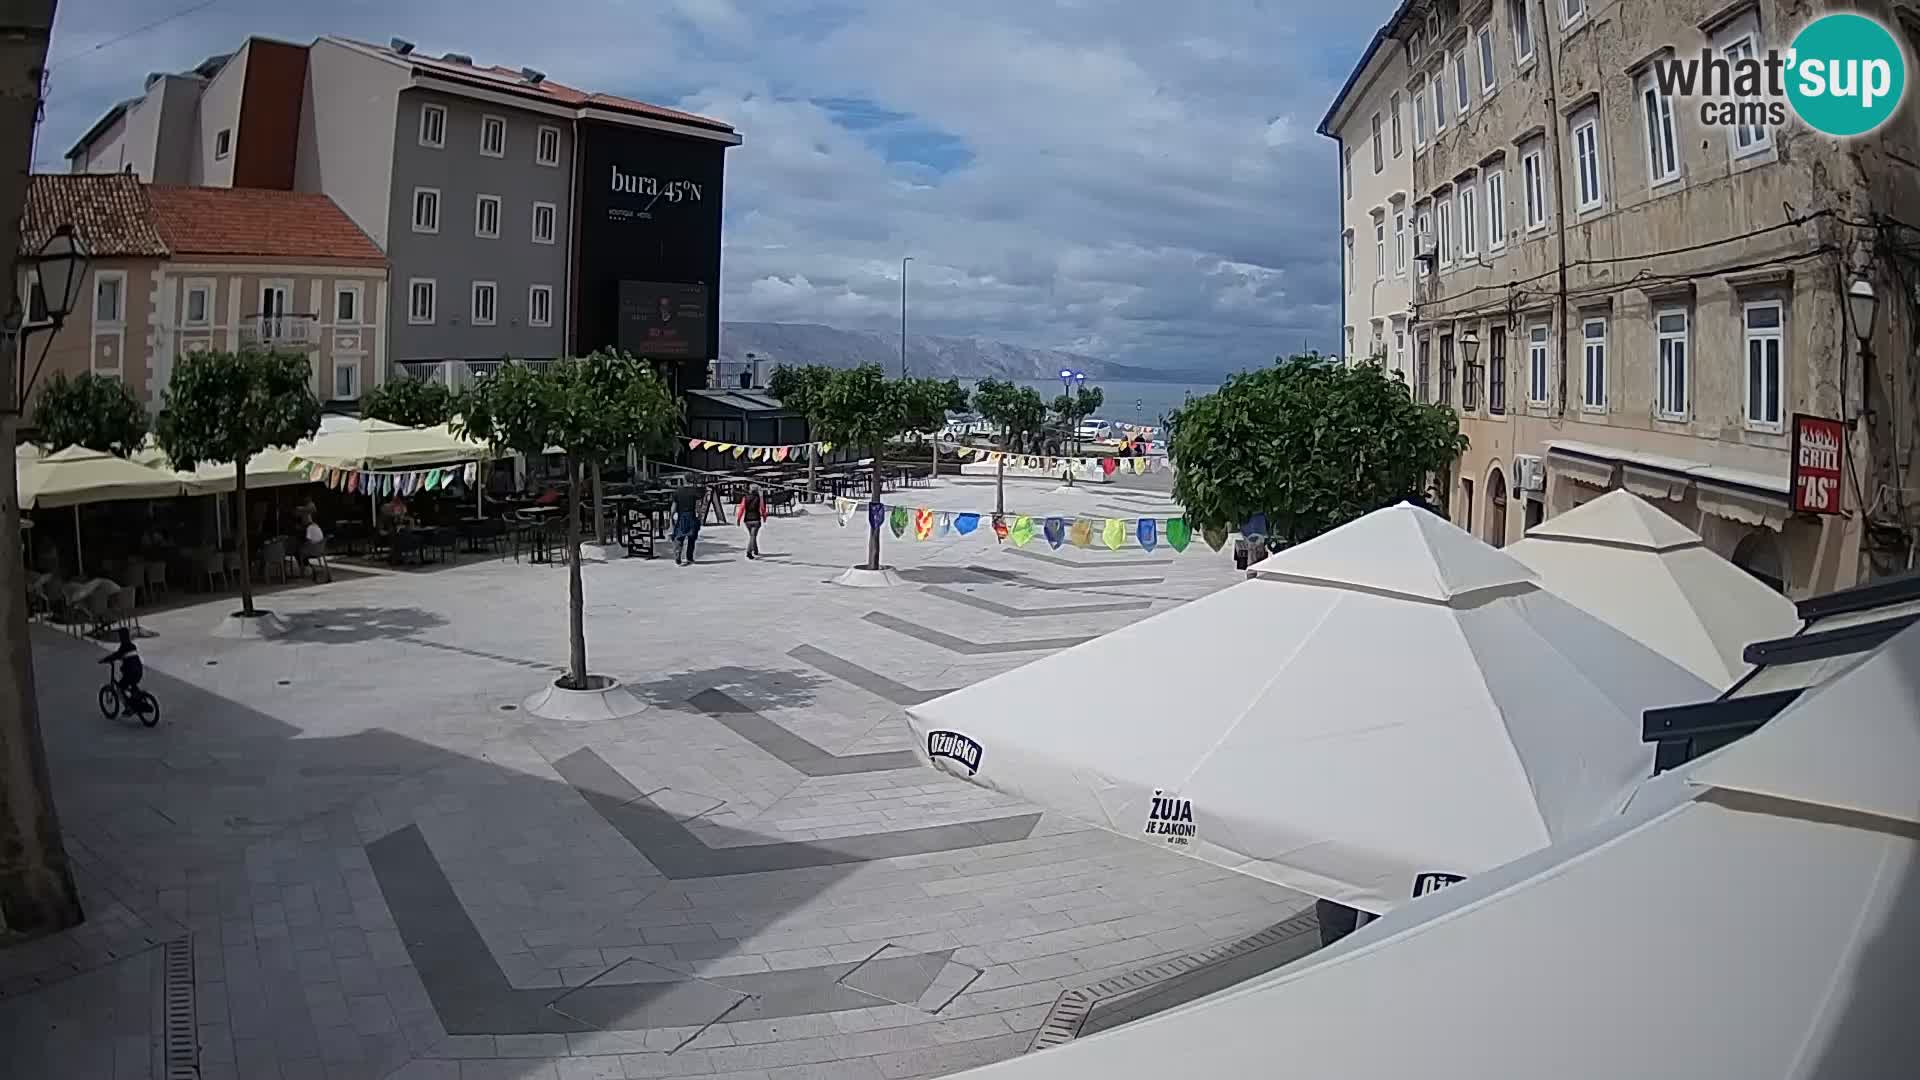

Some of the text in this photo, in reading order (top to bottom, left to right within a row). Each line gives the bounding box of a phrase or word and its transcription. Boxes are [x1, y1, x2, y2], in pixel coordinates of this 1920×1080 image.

[611, 165, 658, 196] bura
[1799, 447, 1839, 471] GRILL
[1797, 476, 1838, 509] "AS"
[931, 733, 978, 765] Ožujsko
[1149, 790, 1193, 822] ŽUJA
[1145, 821, 1196, 837] JE ZAKON!
